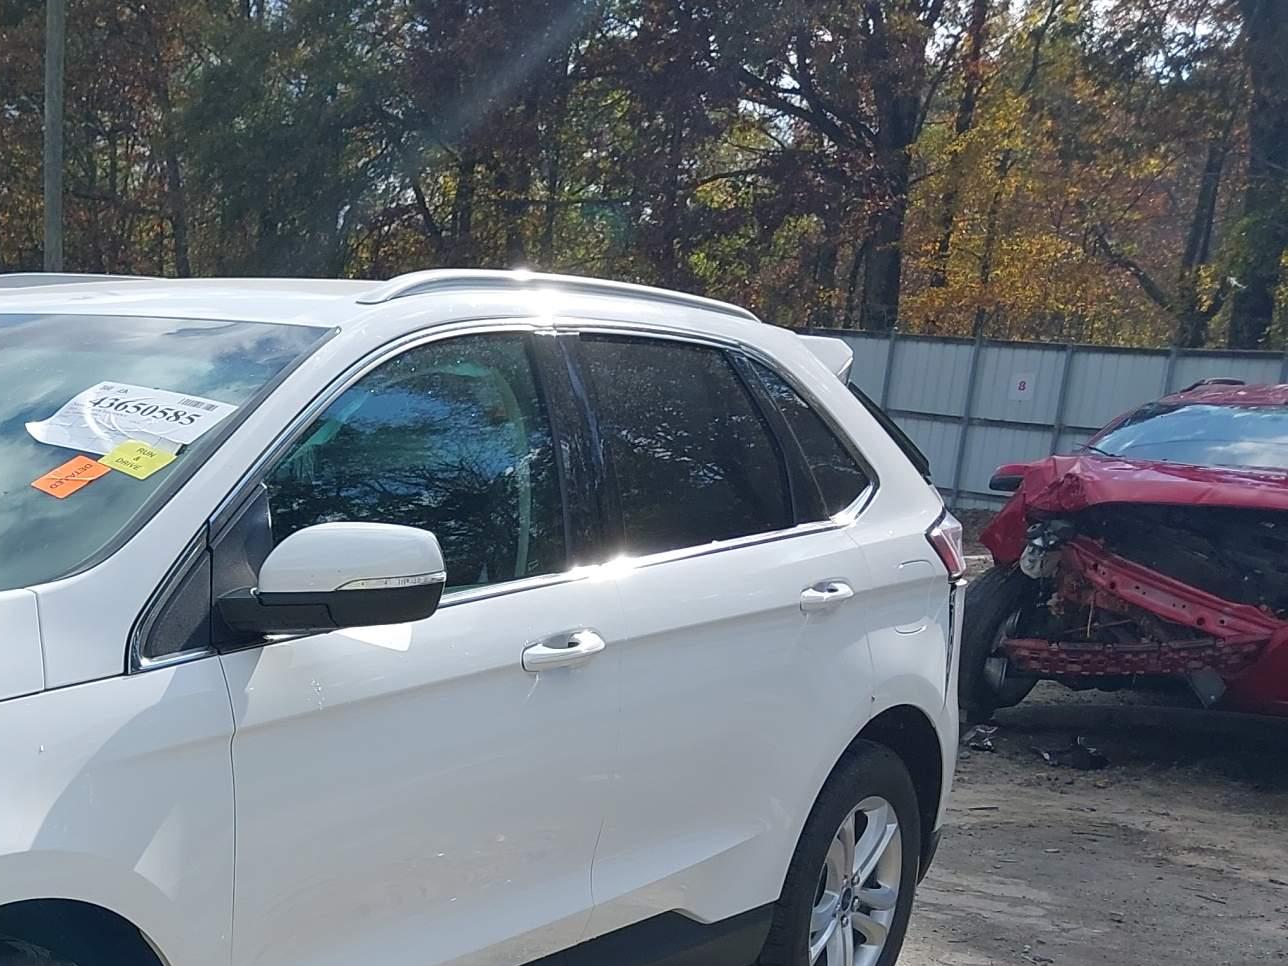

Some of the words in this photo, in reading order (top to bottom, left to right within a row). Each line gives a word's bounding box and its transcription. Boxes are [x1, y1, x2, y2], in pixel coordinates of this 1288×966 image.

[1018, 381, 1027, 391] 8
[89, 396, 202, 426] 43650585
[136, 447, 157, 458] RUN
[115, 457, 143, 471] DRIVE
